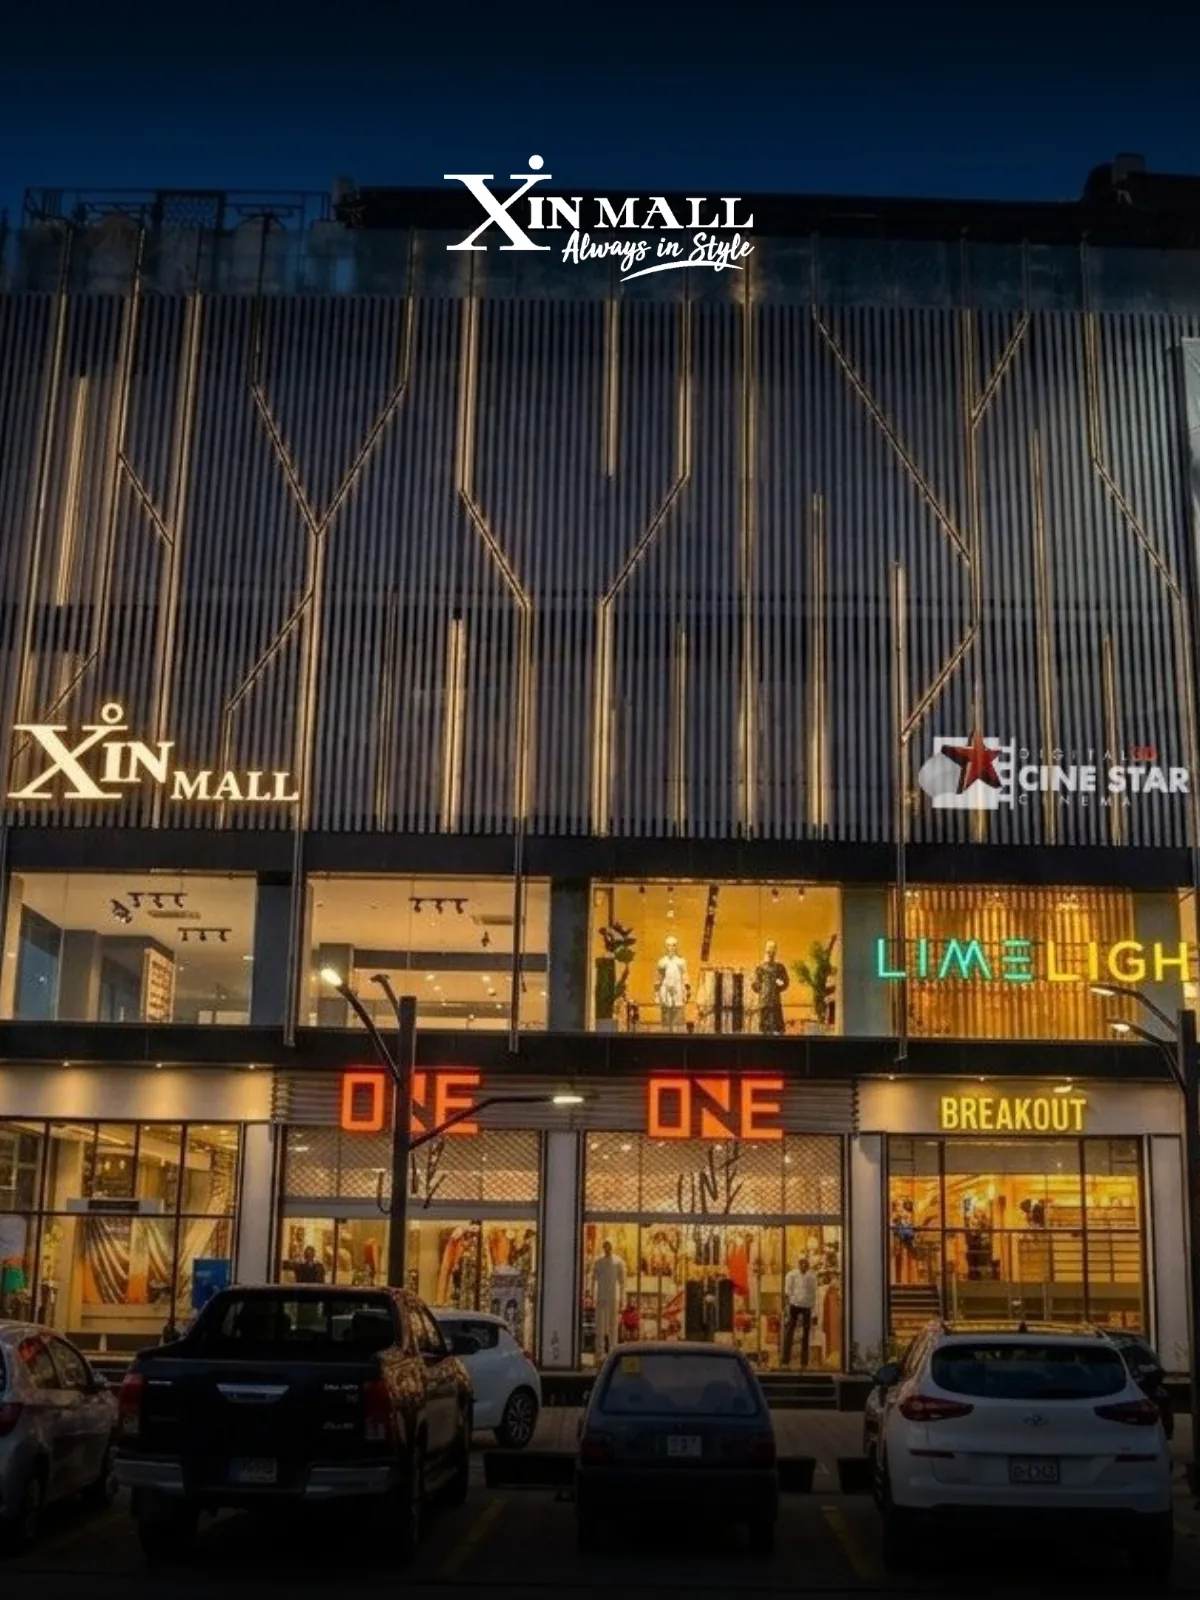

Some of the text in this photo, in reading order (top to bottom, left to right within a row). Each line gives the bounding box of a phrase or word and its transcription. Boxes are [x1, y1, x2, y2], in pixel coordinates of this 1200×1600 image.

[7, 703, 299, 800] XIN MALL
[1018, 765, 1190, 793] CINE STAR
[1018, 793, 1132, 807] CNEMA
[649, 1078, 784, 1138] ONE
[940, 1096, 1087, 1131] BREAKOUT
